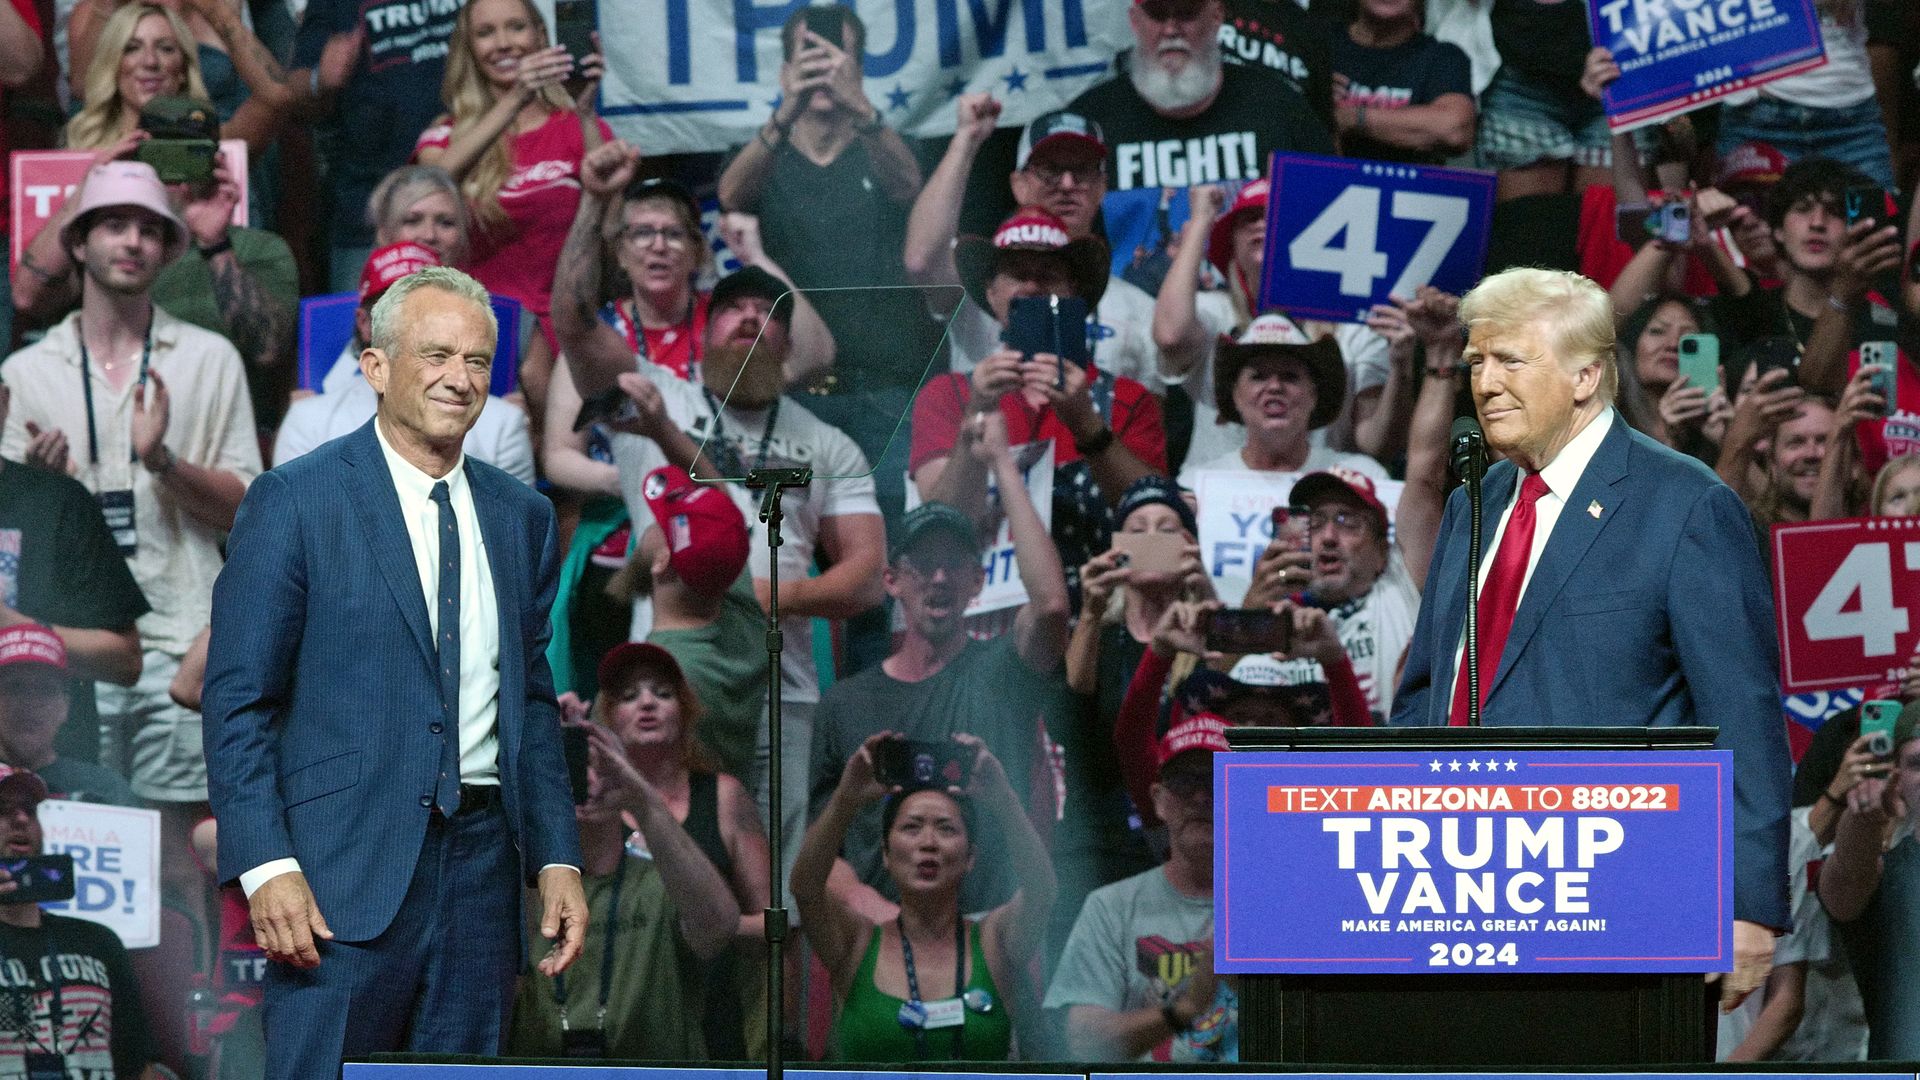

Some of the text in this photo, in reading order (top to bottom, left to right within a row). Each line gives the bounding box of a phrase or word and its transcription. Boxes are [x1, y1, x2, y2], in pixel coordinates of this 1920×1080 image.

[1624, 0, 1777, 54] VANCE
[1217, 24, 1309, 79] RUMP
[1694, 65, 1733, 87] 2024
[1116, 131, 1260, 190] FIGHT!
[1288, 184, 1471, 301] 47
[1802, 541, 1920, 657] 4
[1281, 786, 1667, 811] TEXT ARIZONA TO 88022
[44, 825, 121, 844] MALA
[1322, 817, 1626, 870] TRUMP
[1356, 871, 1590, 915] VANCE
[1341, 919, 1606, 932] MAKE AMERICA GREAT AGAIN!
[1429, 942, 1519, 967] 2024
